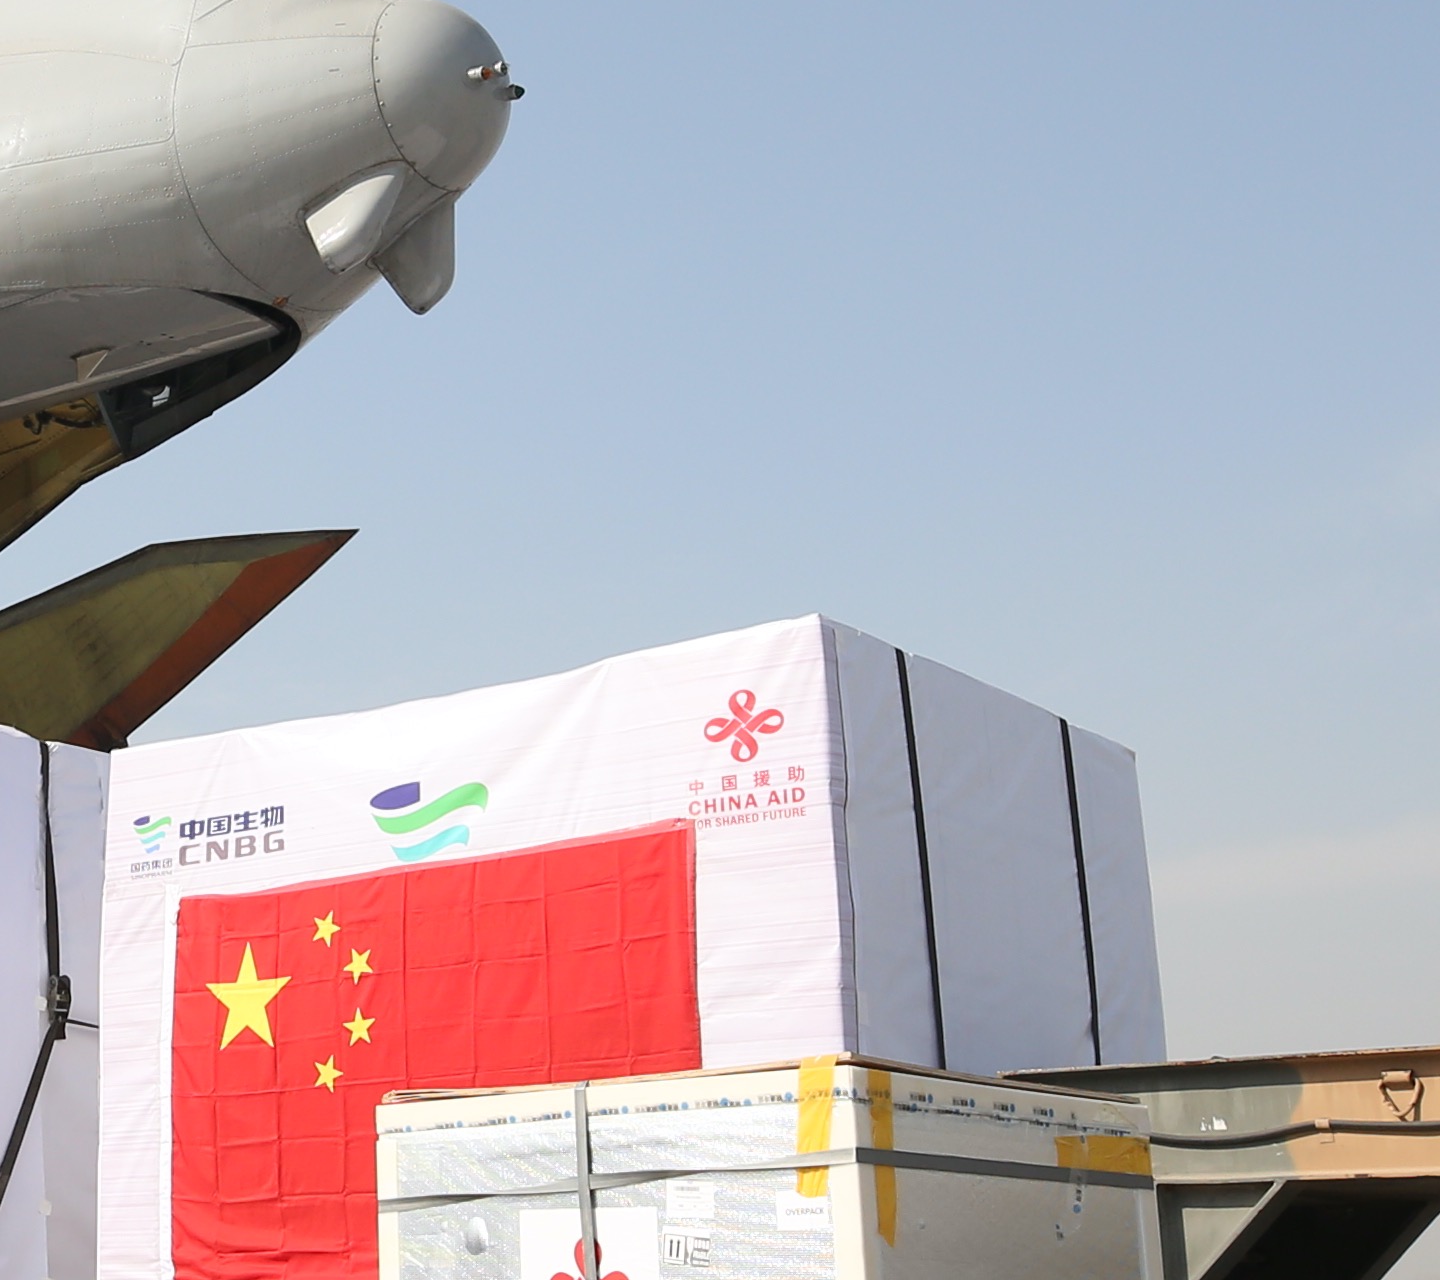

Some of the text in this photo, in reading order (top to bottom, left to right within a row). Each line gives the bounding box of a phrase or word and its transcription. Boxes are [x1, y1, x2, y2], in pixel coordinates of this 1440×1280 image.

[688, 765, 805, 796] 中国援助
[688, 787, 806, 816] CHINA AID
[179, 805, 285, 840] 中国生物
[697, 806, 807, 830] OR SHARED FUTURE
[179, 829, 285, 866] CNBG
[785, 1206, 825, 1216] OVERPACK
